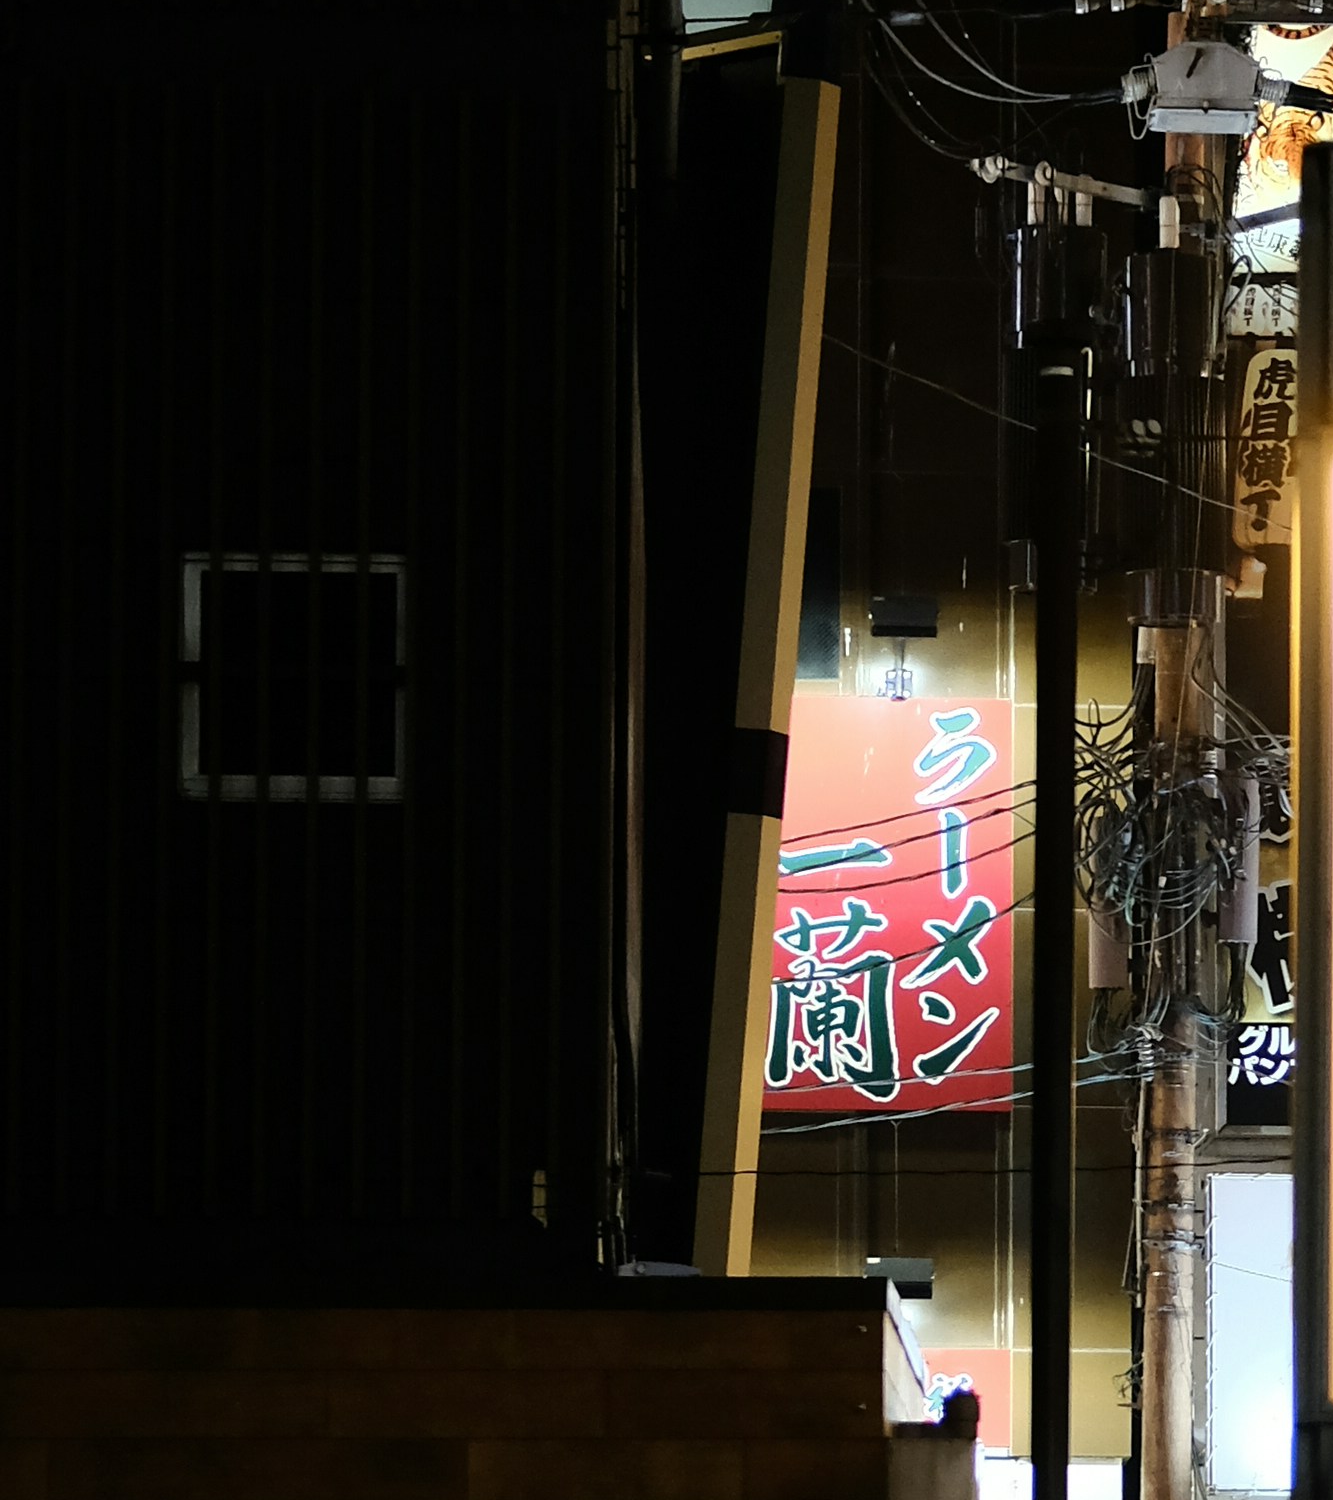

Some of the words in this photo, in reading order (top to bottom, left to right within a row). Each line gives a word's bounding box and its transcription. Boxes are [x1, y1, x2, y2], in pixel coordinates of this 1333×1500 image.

[1240, 357, 1297, 532] 虎目横丁
[765, 837, 901, 1103] 一蘭
[900, 706, 1001, 1086] ラーメン
[1227, 1055, 1296, 1086] パン
